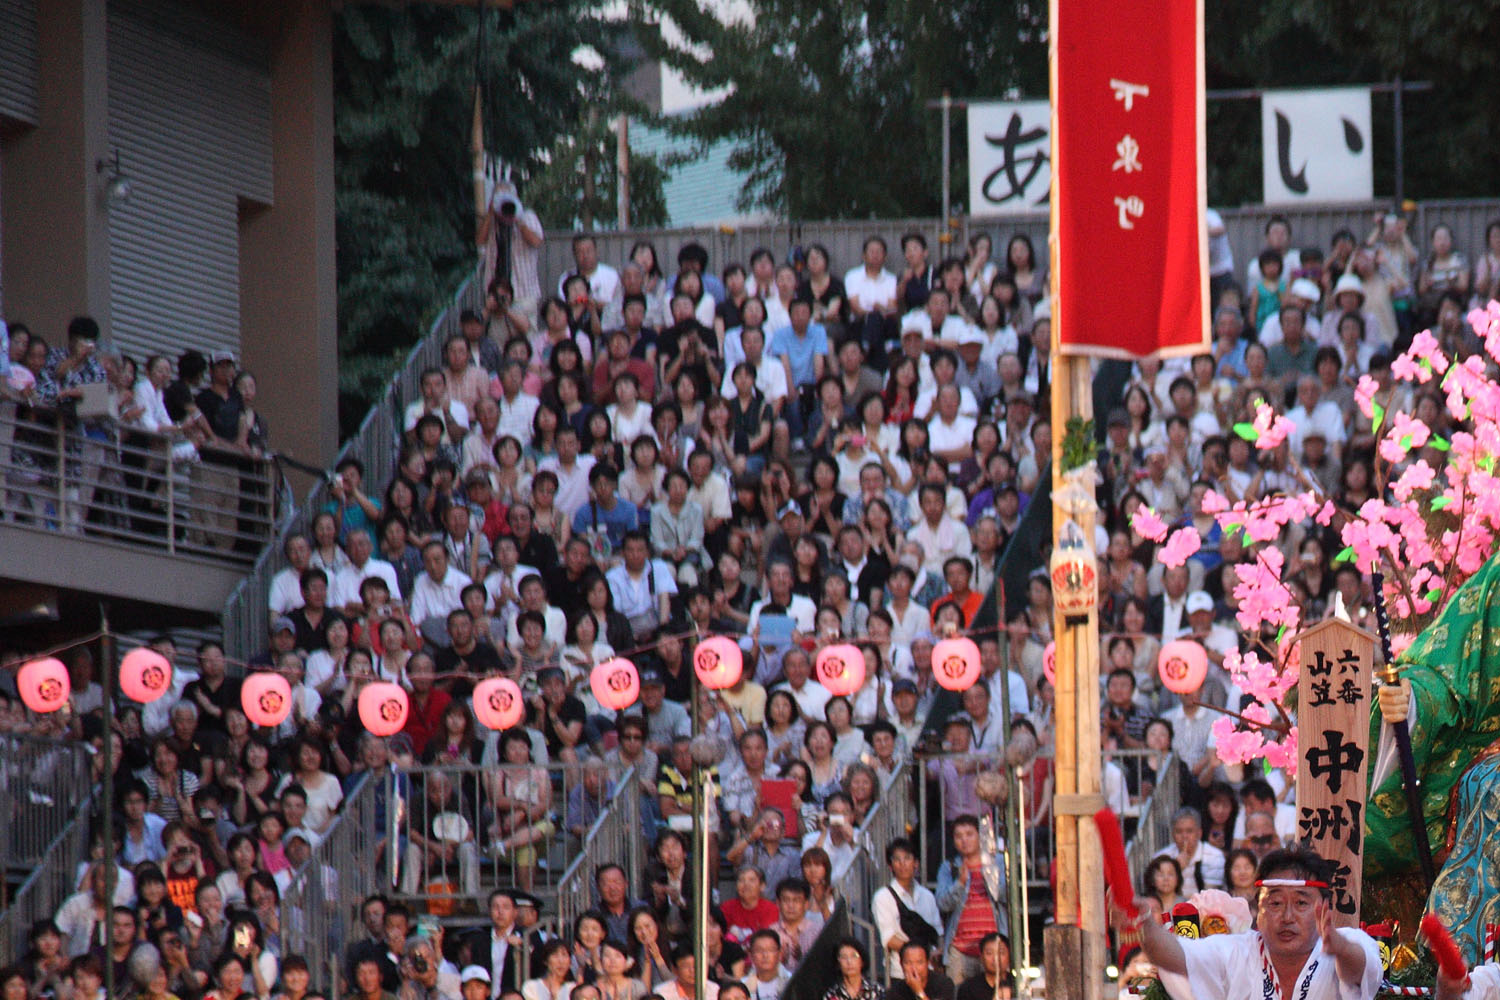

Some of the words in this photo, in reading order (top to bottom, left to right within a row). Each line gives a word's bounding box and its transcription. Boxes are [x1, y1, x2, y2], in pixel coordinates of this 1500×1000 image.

[982, 111, 1050, 205] あ
[1275, 107, 1365, 195] い
[1306, 651, 1336, 708] 山笠
[1336, 649, 1364, 706] 六番
